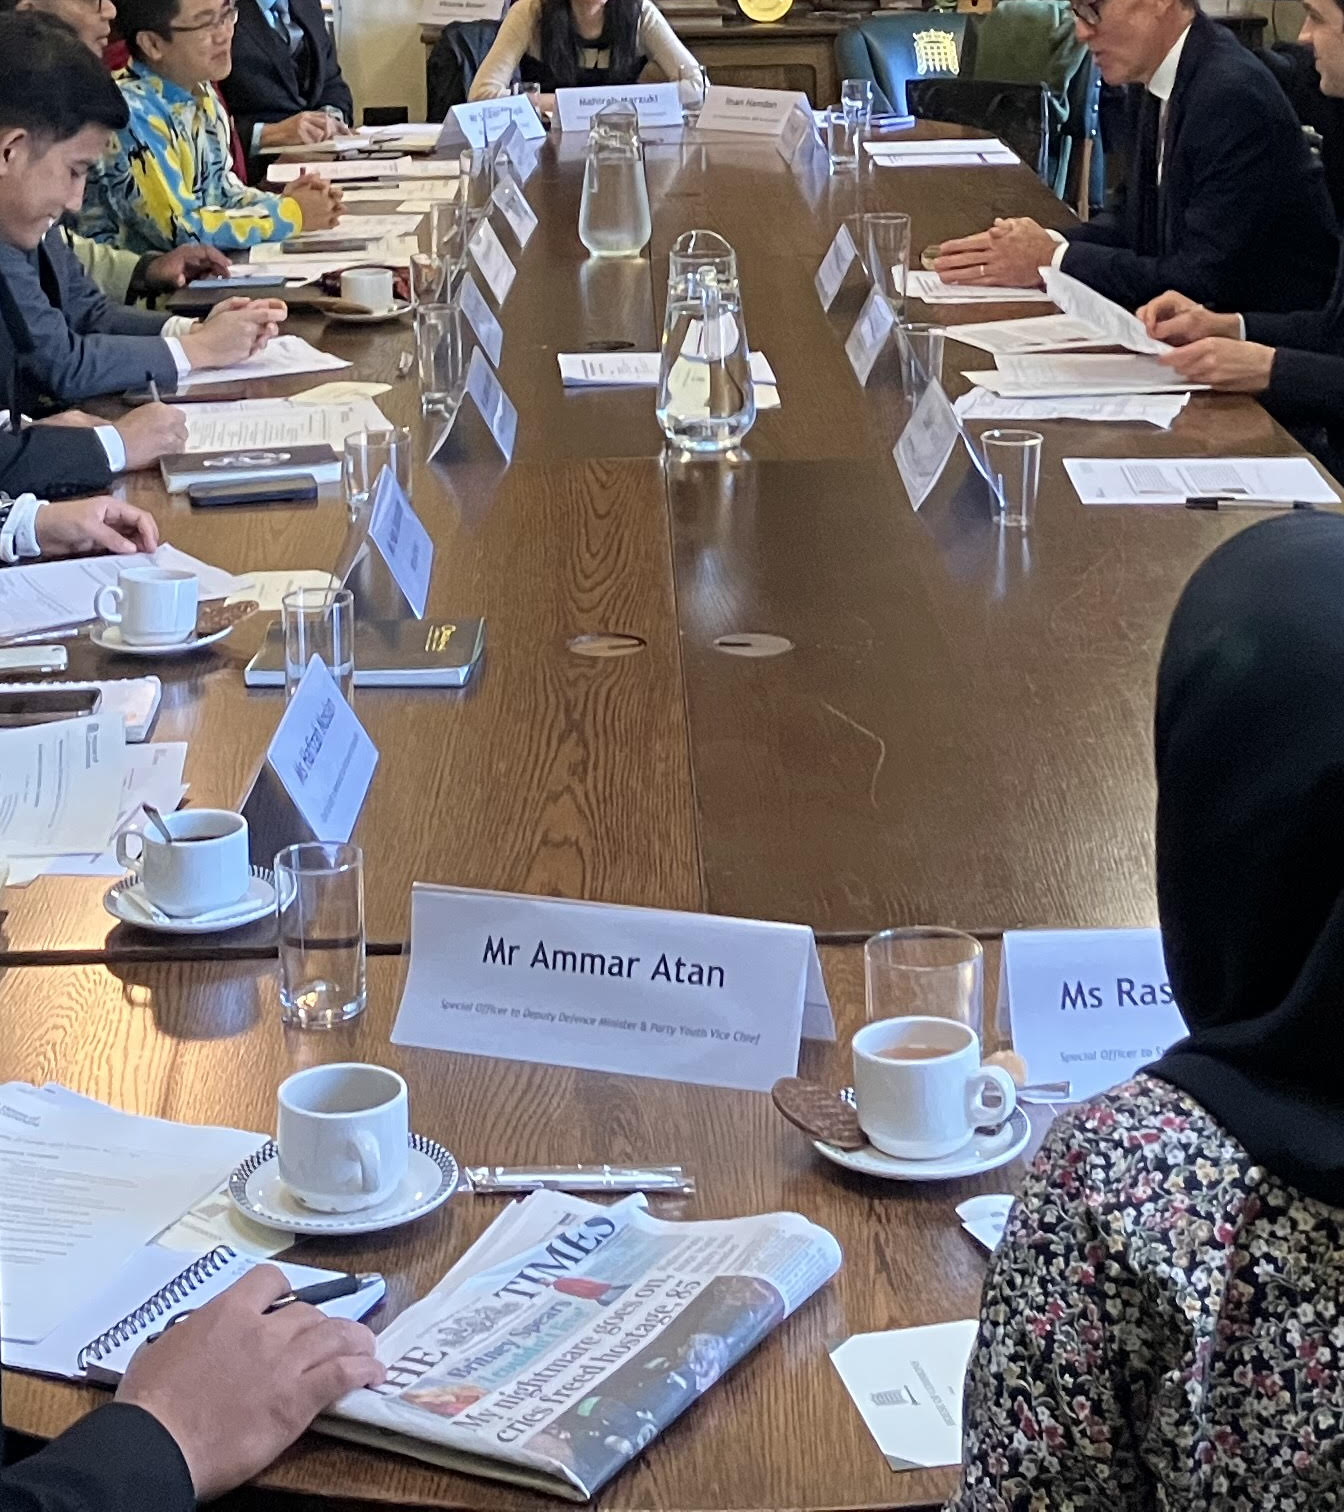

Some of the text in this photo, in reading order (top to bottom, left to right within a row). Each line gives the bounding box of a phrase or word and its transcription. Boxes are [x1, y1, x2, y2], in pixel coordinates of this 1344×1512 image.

[482, 934, 726, 989] Mr Ammar Atan
[1060, 977, 1175, 1010] Ms Ras
[441, 998, 473, 1012] Special
[475, 1002, 508, 1015] Officer
[510, 1007, 521, 1017] to
[522, 1008, 556, 1023] Deputy
[558, 1012, 597, 1025] Defence
[598, 1017, 637, 1030] Minister
[650, 1022, 676, 1037] Party
[679, 1024, 707, 1038] Youth
[710, 1028, 731, 1040] Vice
[733, 1030, 761, 1046] Chief
[1060, 1050, 1096, 1064] Special
[1100, 1049, 1137, 1062] Officer
[1141, 1048, 1153, 1059] to
[492, 1216, 616, 1300] TIMES
[447, 1338, 521, 1379] Britney
[509, 1300, 572, 1338] Spears
[452, 1404, 504, 1433] My
[501, 1335, 601, 1411] nightmare
[594, 1297, 643, 1336] goes
[634, 1274, 676, 1299] on,
[497, 1406, 554, 1443] cries
[540, 1356, 607, 1405] freed
[597, 1301, 683, 1364] hostage,
[665, 1279, 702, 1302] 85
